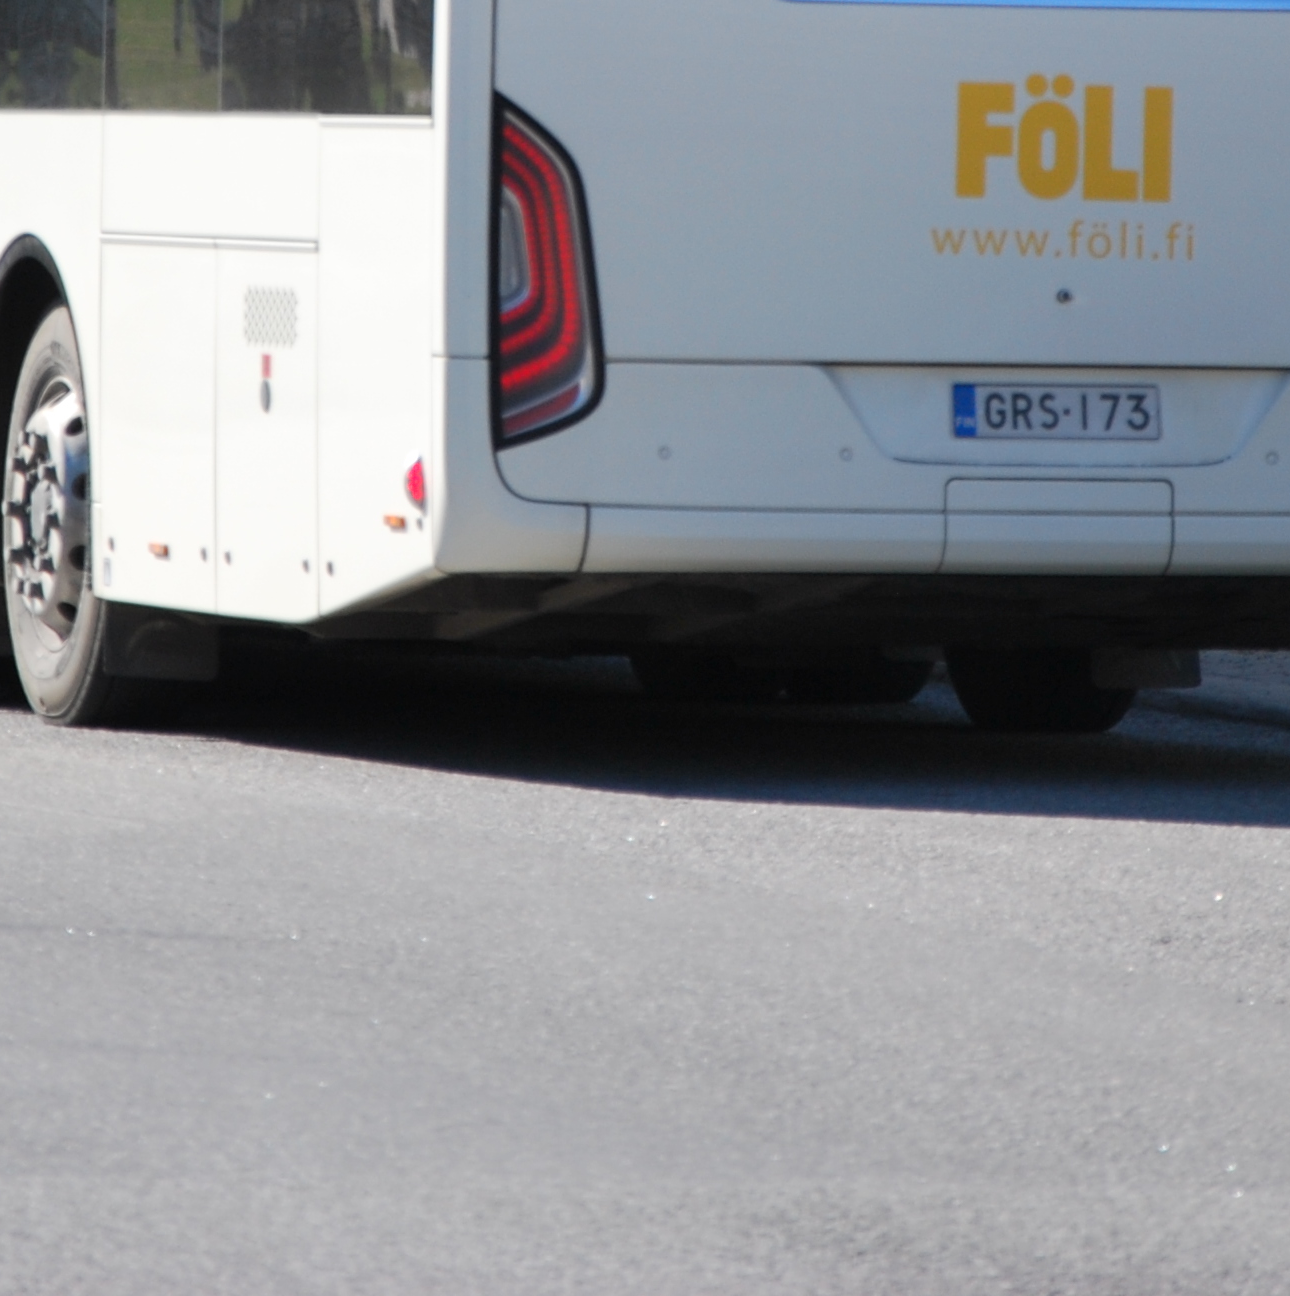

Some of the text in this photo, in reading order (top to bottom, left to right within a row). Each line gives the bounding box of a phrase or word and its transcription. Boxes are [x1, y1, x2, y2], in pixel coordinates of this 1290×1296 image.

[955, 73, 1173, 202] FÖLI
[931, 220, 1196, 261] www.föli.fi
[983, 391, 1151, 432] GRS-173
